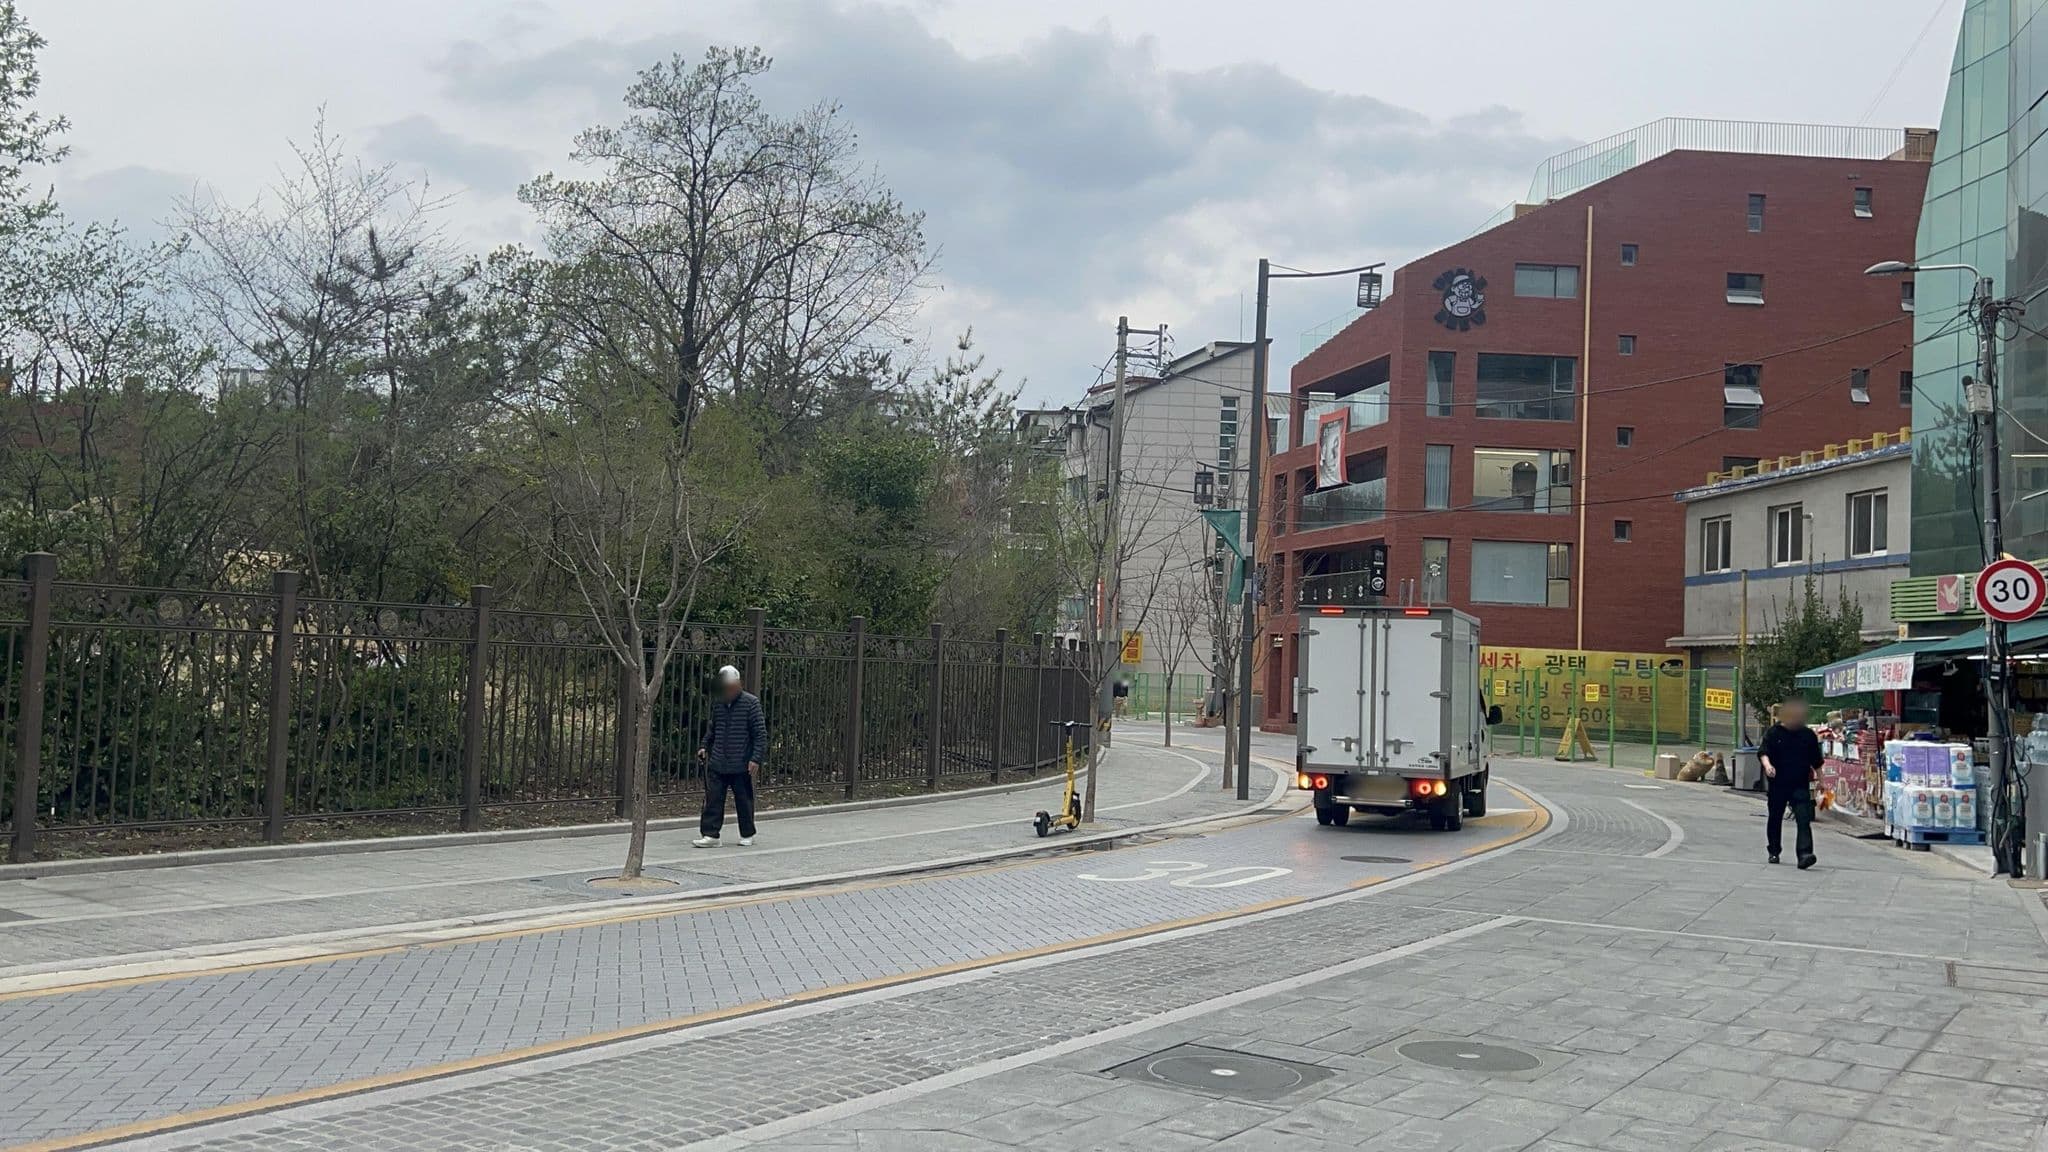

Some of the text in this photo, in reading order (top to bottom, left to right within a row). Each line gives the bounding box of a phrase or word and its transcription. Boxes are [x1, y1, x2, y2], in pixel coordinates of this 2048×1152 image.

[1992, 578, 2030, 602] 30
[1480, 652, 1653, 679] 세차 광택 코팅
[1077, 861, 1294, 889] 30
